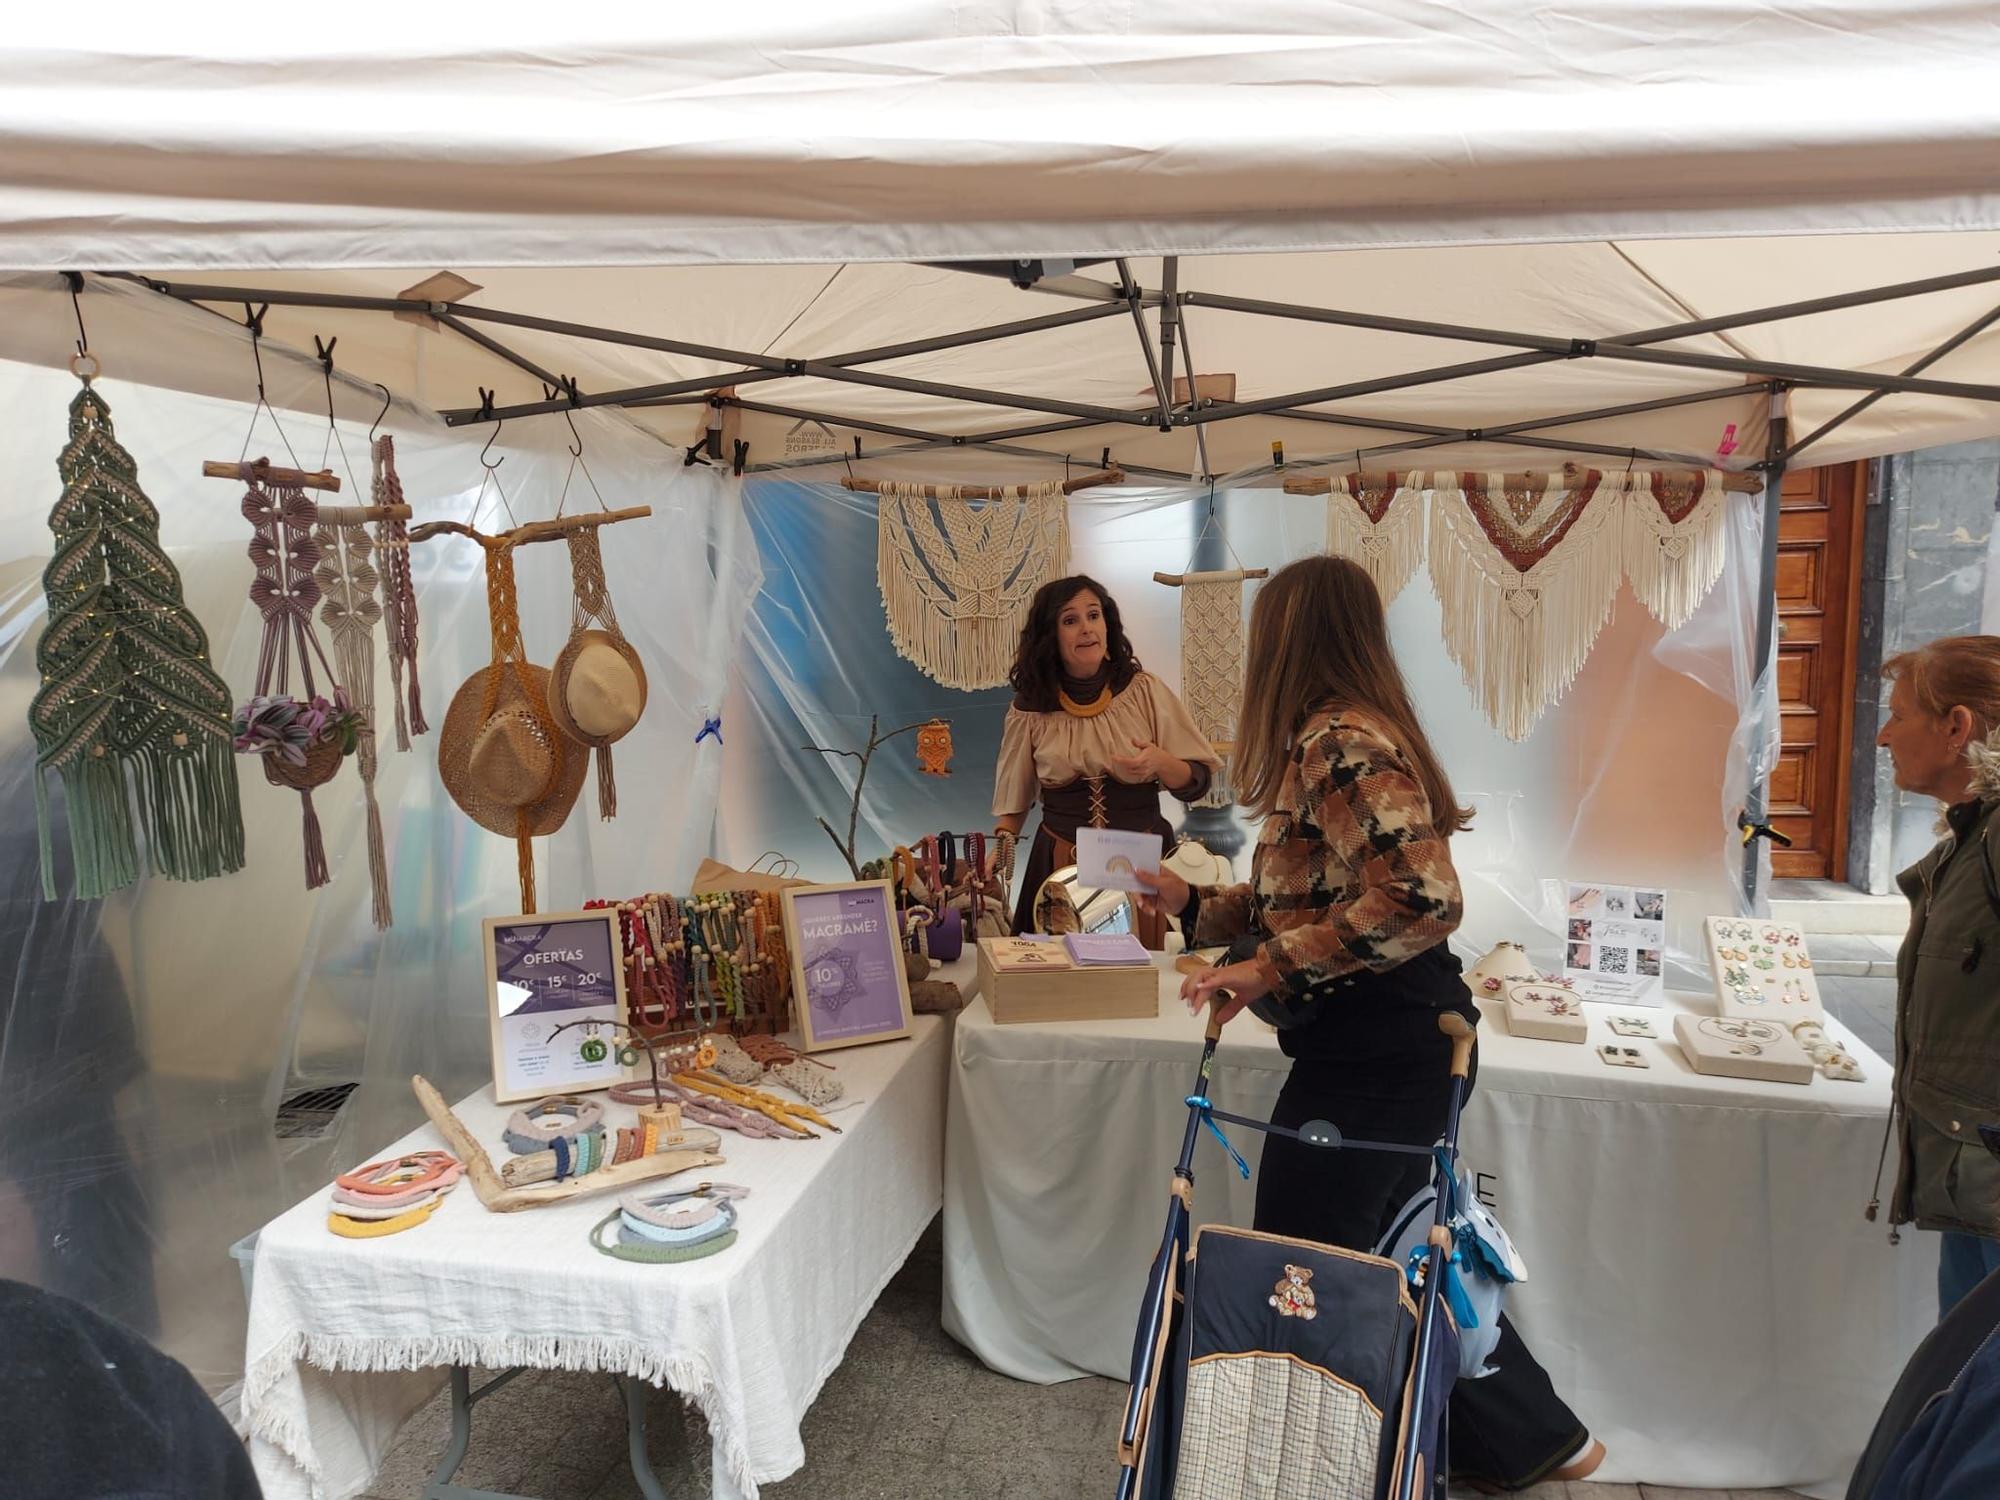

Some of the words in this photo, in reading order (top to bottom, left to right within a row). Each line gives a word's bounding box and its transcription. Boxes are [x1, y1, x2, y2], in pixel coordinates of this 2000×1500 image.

[802, 918, 878, 940] MACRAMÉ?
[523, 949, 584, 965] OFERTAS
[547, 974, 567, 988] 15€
[577, 971, 603, 986] 20€
